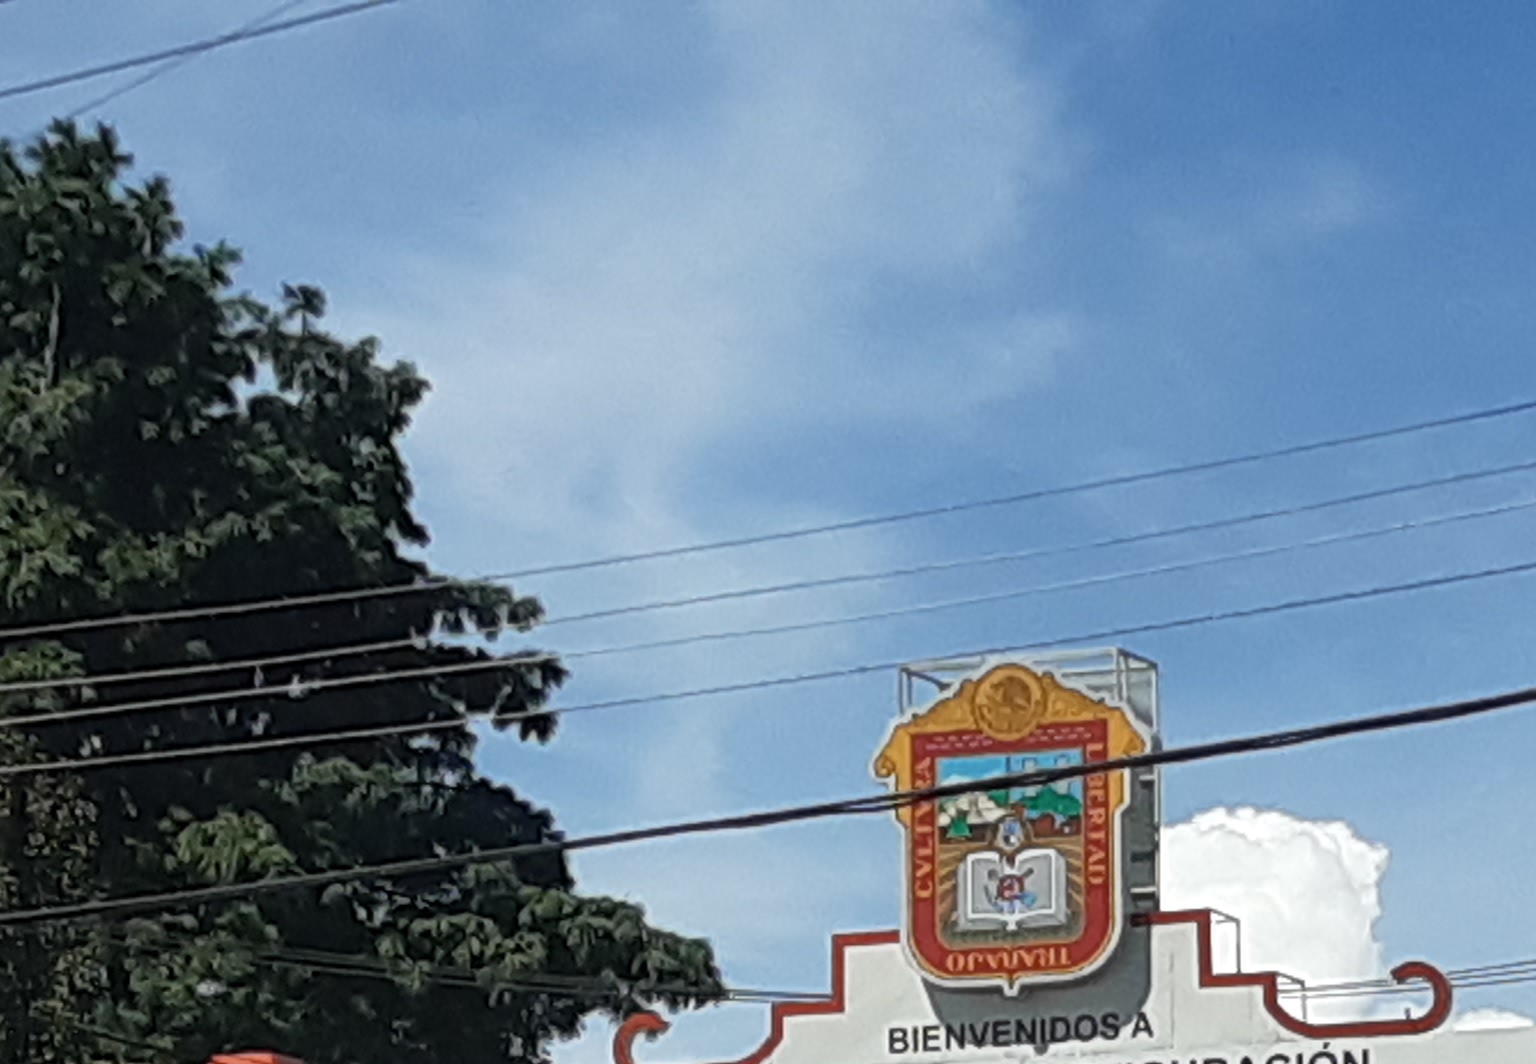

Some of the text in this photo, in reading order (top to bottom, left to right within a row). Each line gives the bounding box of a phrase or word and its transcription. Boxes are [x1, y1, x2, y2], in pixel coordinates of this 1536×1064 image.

[1086, 741, 1107, 886] LBERTAD
[888, 1011, 1155, 1054] BIENVENIDOS A
